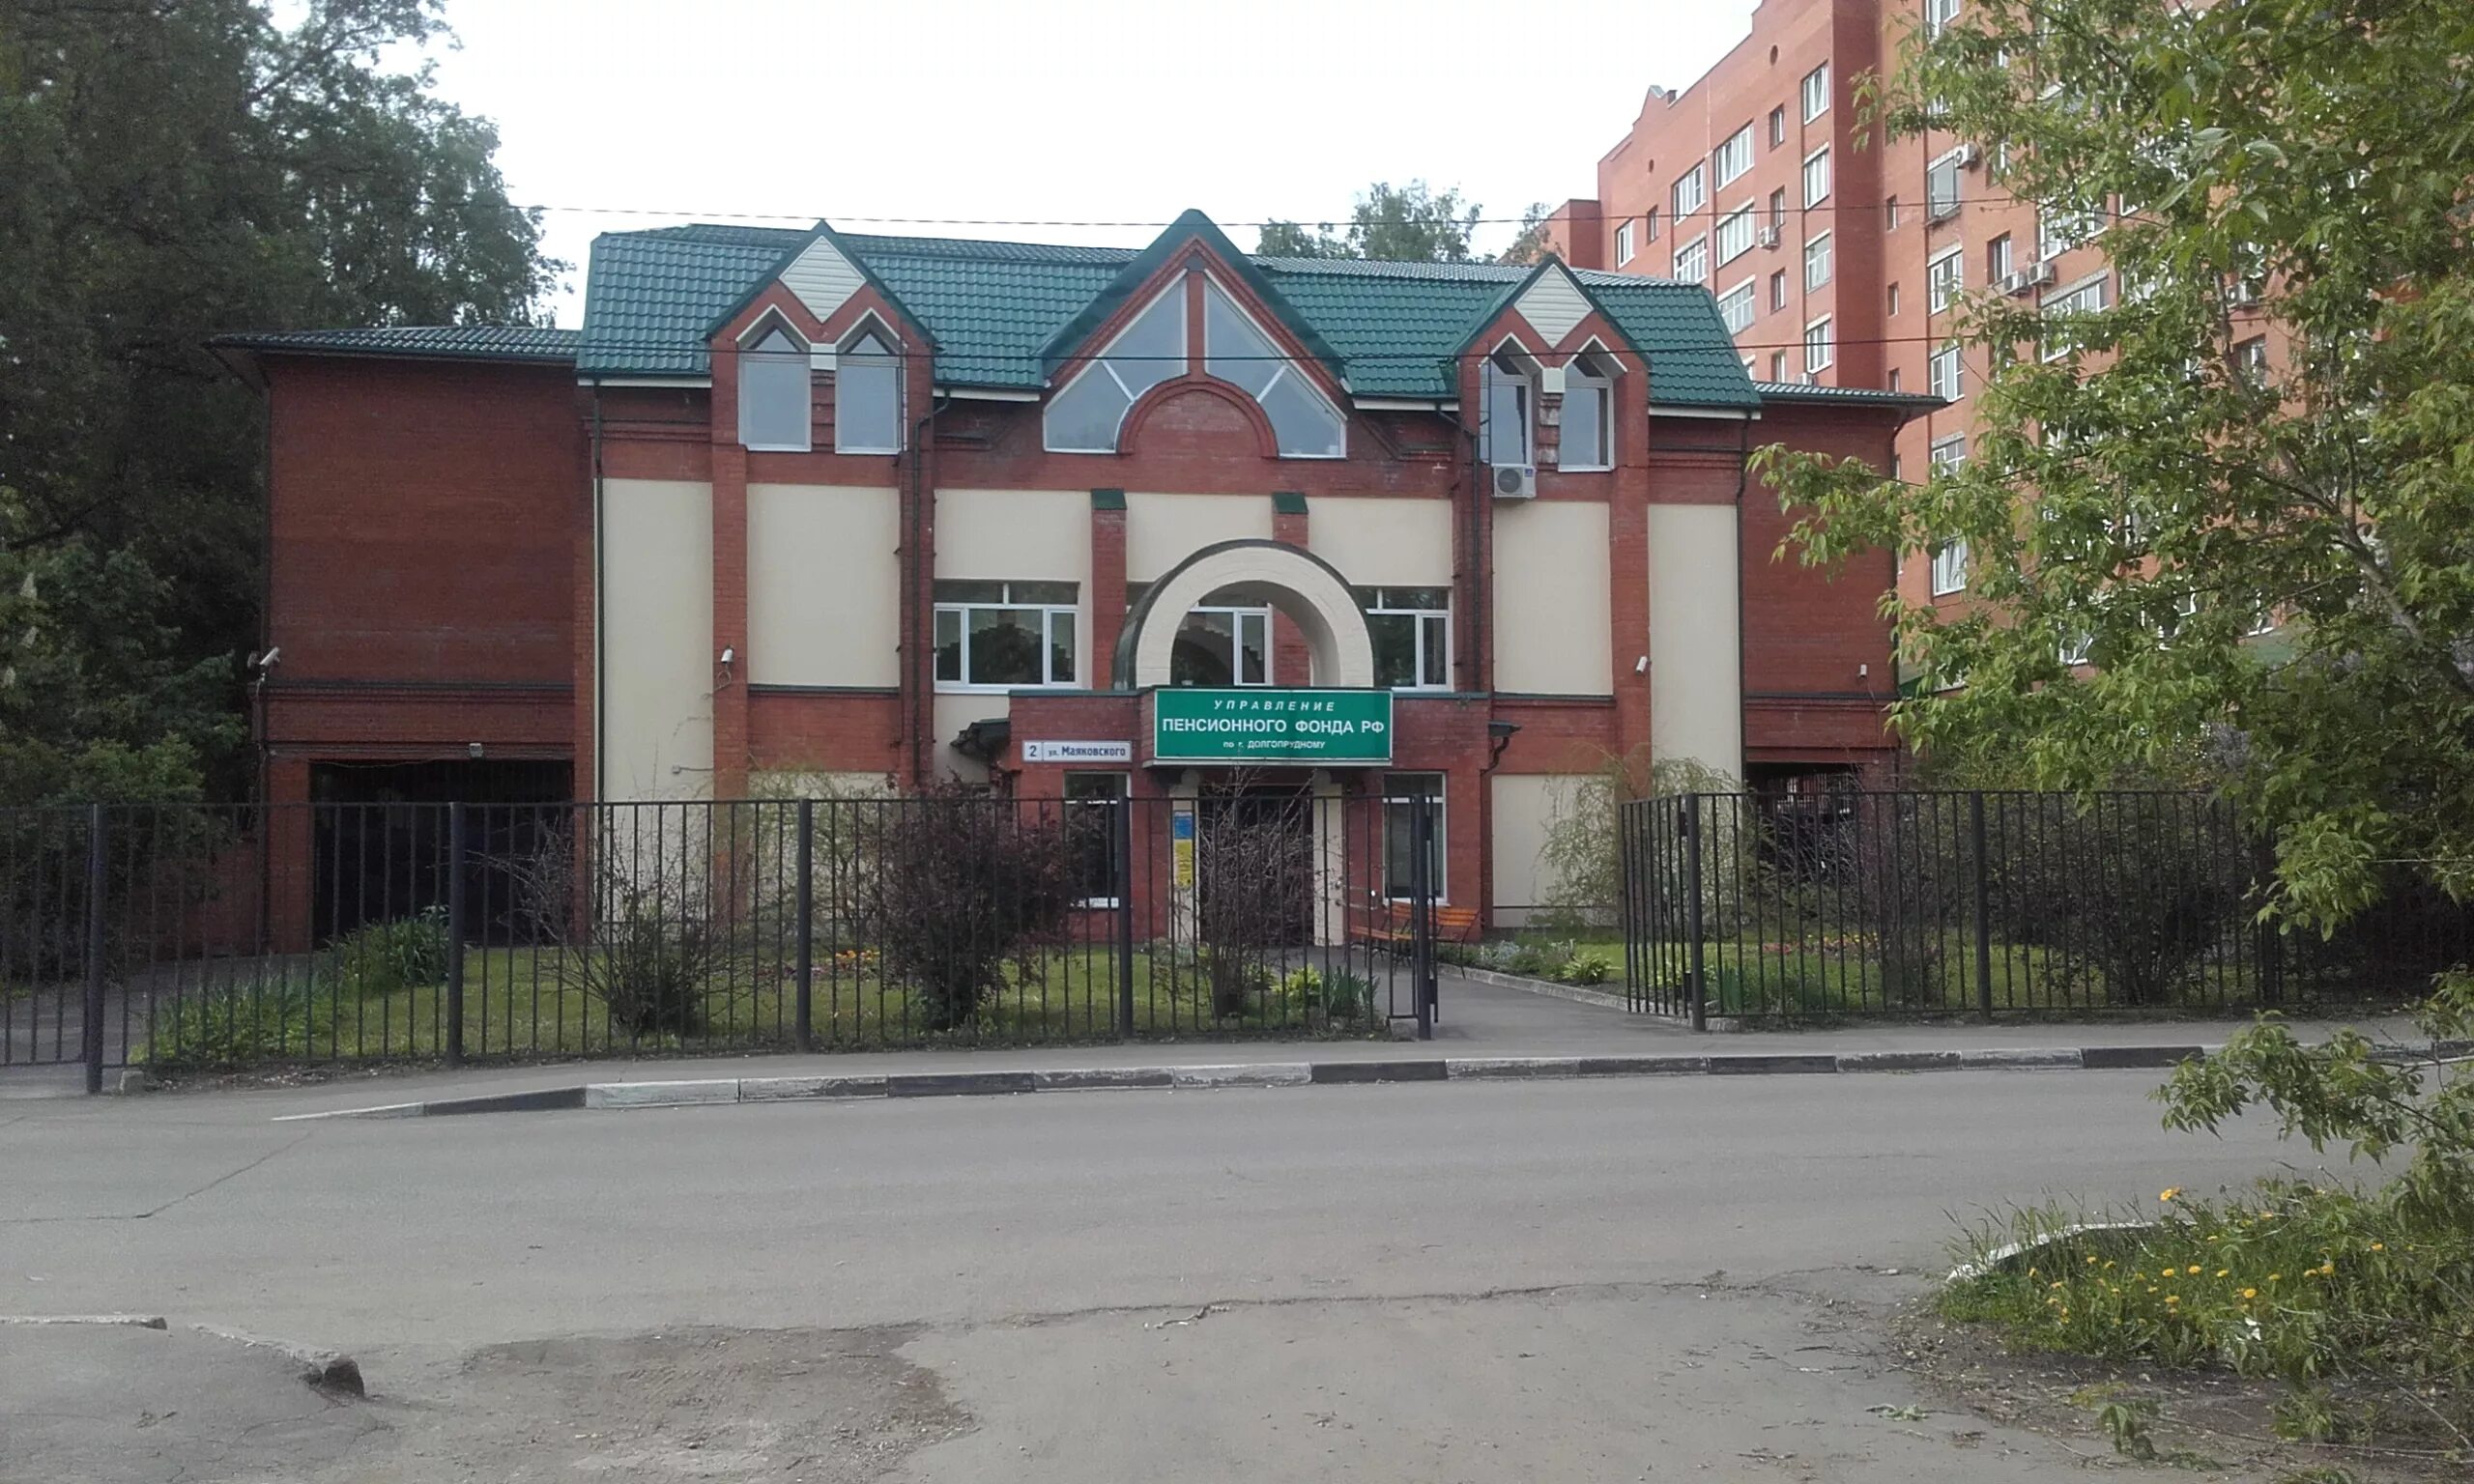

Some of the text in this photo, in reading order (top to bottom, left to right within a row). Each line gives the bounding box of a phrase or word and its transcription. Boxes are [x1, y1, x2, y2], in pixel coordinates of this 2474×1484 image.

[1214, 699, 1335, 712] УПРАВЛЕНИЕ
[1163, 718, 1385, 735] ПЕНСИОННОГО ФОНДА РФ
[1028, 745, 1126, 757] 2 ул. Маяковского
[1248, 740, 1326, 750] ДОЛГОПРУДНОМУ
